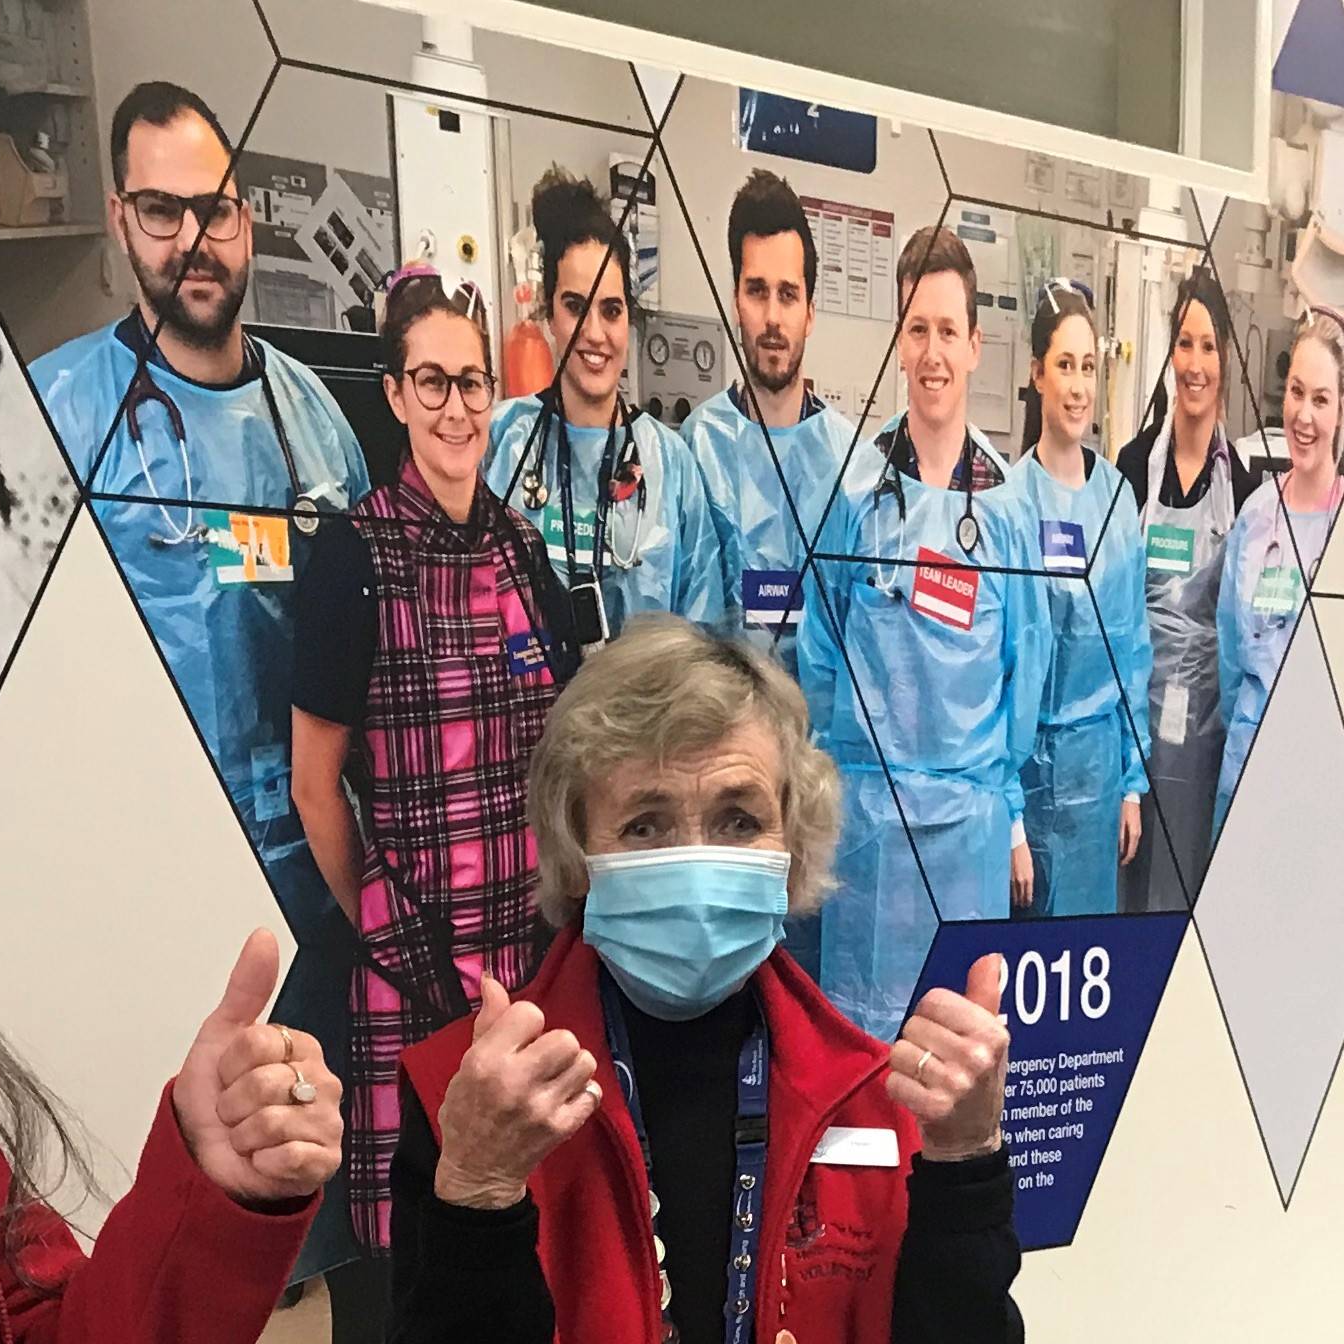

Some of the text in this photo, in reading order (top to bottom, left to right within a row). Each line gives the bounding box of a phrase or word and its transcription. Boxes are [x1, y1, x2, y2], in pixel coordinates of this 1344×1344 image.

[758, 583, 790, 597] AIRWAY
[919, 566, 975, 599] TEAM LEADER
[1007, 1048, 1124, 1076] ergency Department
[1019, 1077, 1057, 1098] 75,000
[1059, 1073, 1105, 1096] patients
[1010, 1102, 1059, 1121] member
[1060, 1099, 1073, 1115] of
[1075, 1097, 1093, 1113] the
[1015, 1127, 1046, 1144] when
[1048, 1122, 1084, 1139] caring
[1008, 1149, 1062, 1168] and these
[1018, 1171, 1054, 1190] on the
